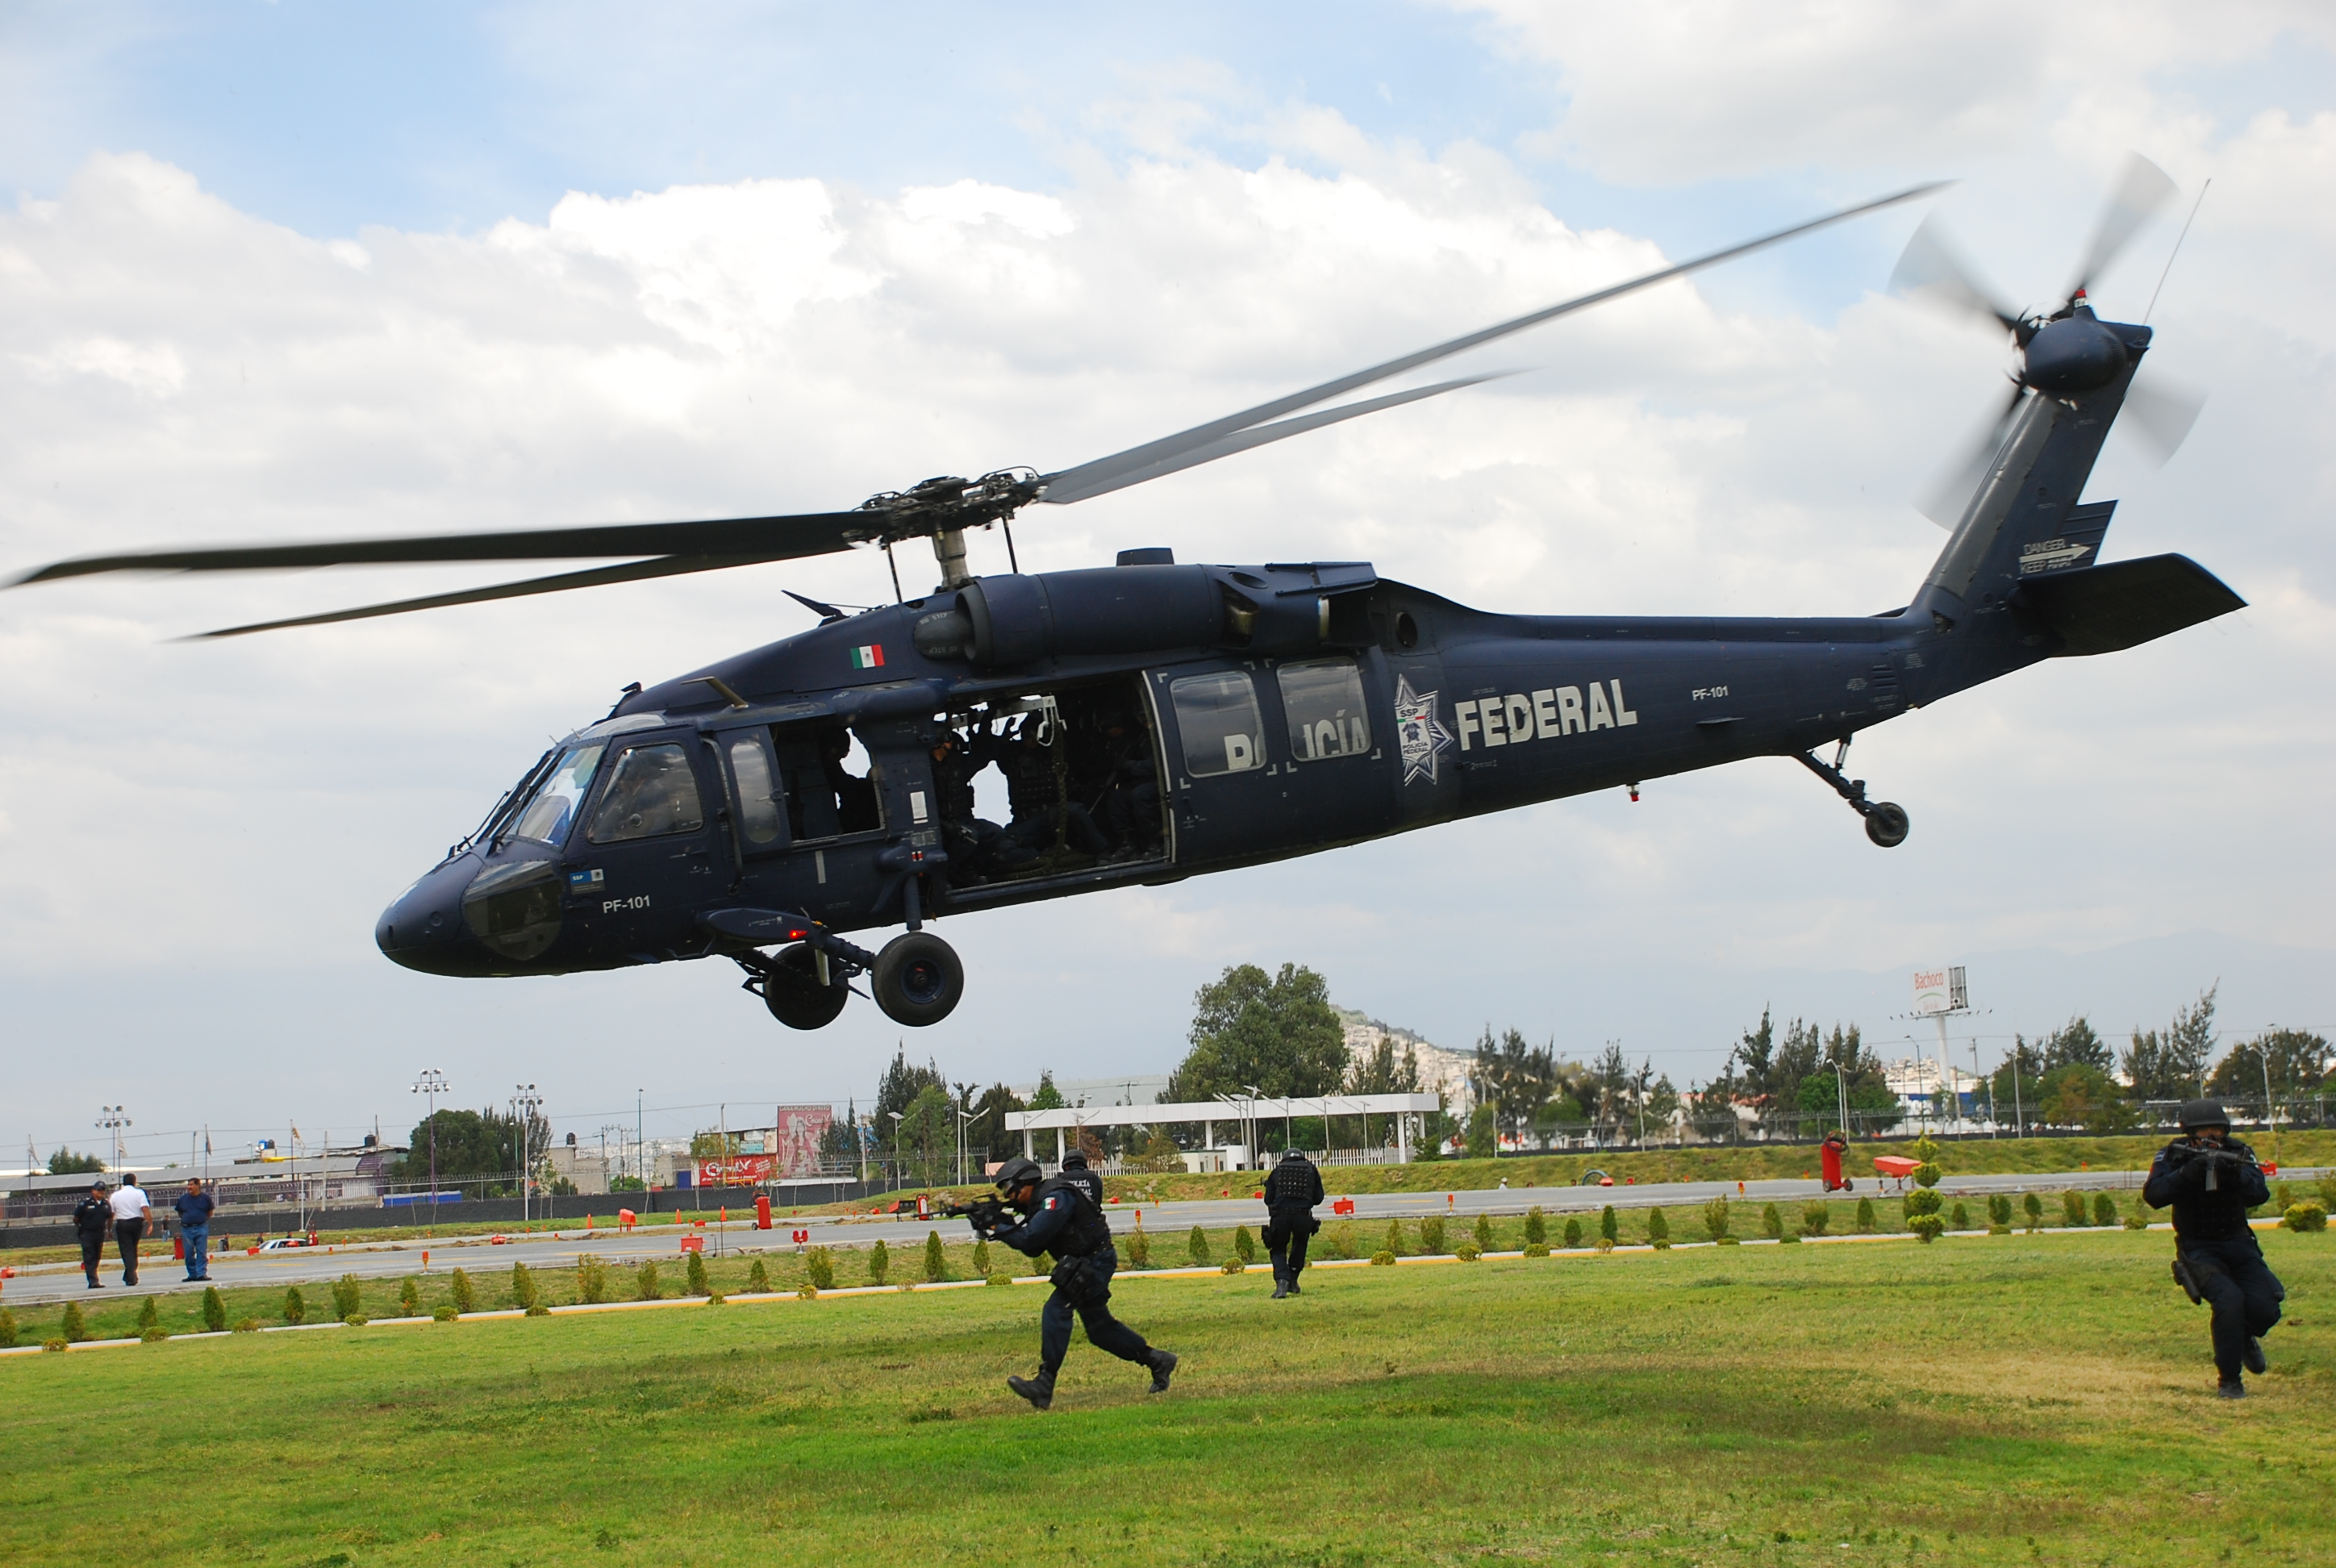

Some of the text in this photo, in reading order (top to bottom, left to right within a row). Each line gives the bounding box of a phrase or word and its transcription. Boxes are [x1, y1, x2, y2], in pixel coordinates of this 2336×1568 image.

[2023, 538, 2066, 555] DANGER
[2018, 561, 2047, 574] KEEP
[1692, 686, 1729, 702] PF-101
[1400, 707, 1419, 718] SSP
[1454, 678, 1638, 752] FEDERAL
[603, 895, 651, 914] PF-101
[1914, 971, 1944, 990] Bachoco
